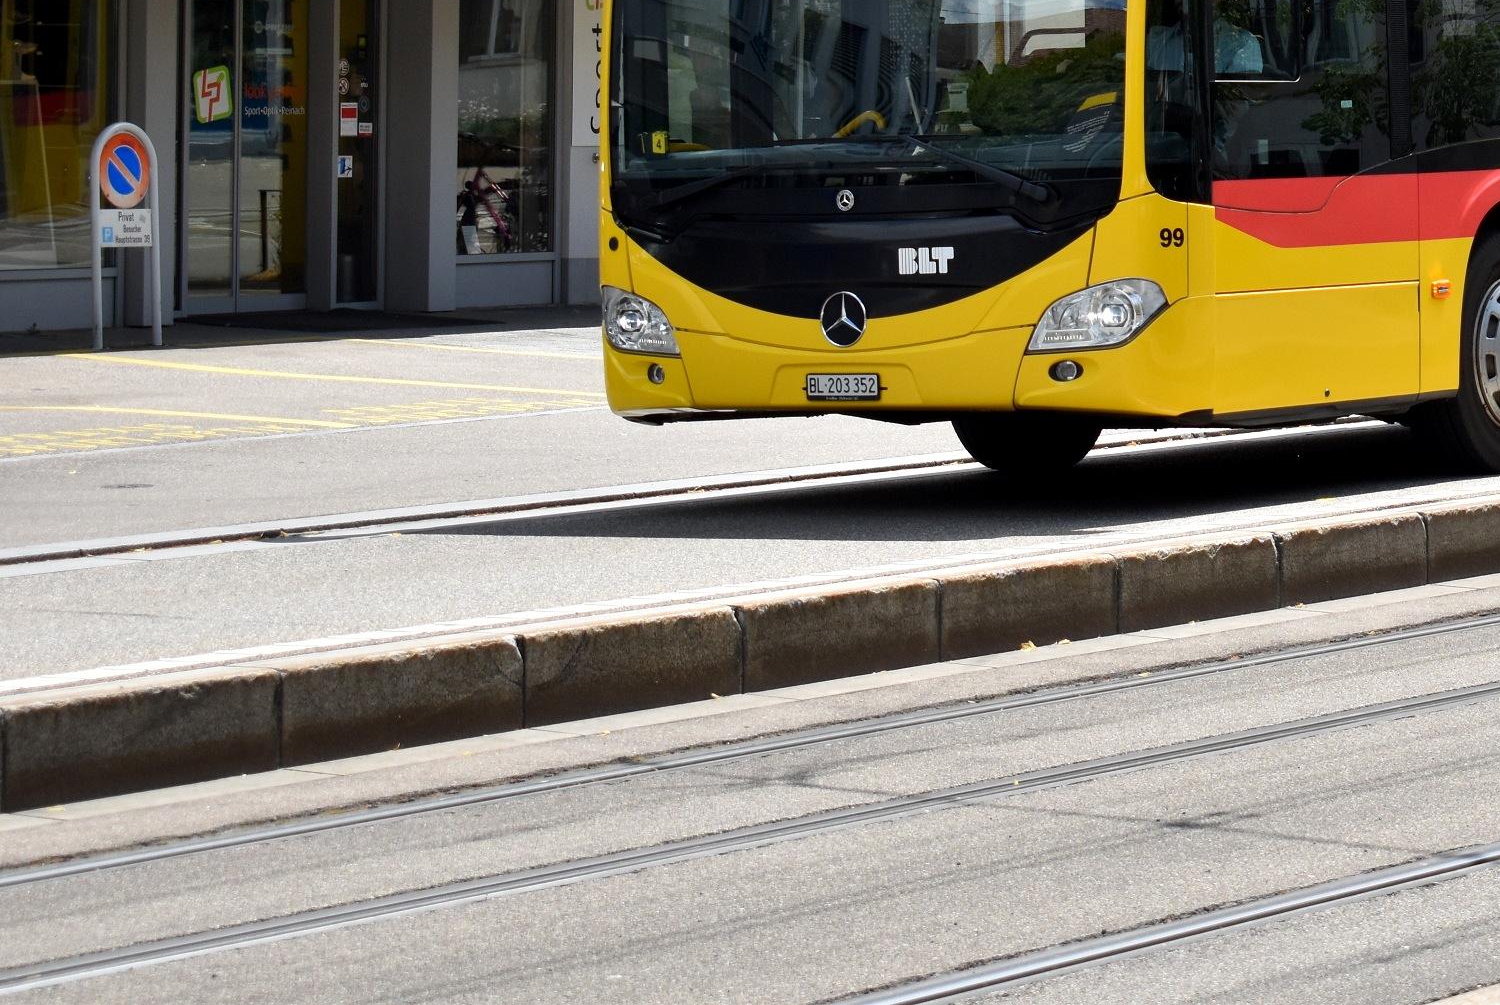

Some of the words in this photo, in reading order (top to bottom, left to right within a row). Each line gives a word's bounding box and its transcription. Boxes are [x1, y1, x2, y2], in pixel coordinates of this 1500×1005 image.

[655, 137, 662, 151] 4
[118, 212, 135, 222] Privat
[1159, 227, 1185, 248] 99
[898, 246, 955, 275] BLT
